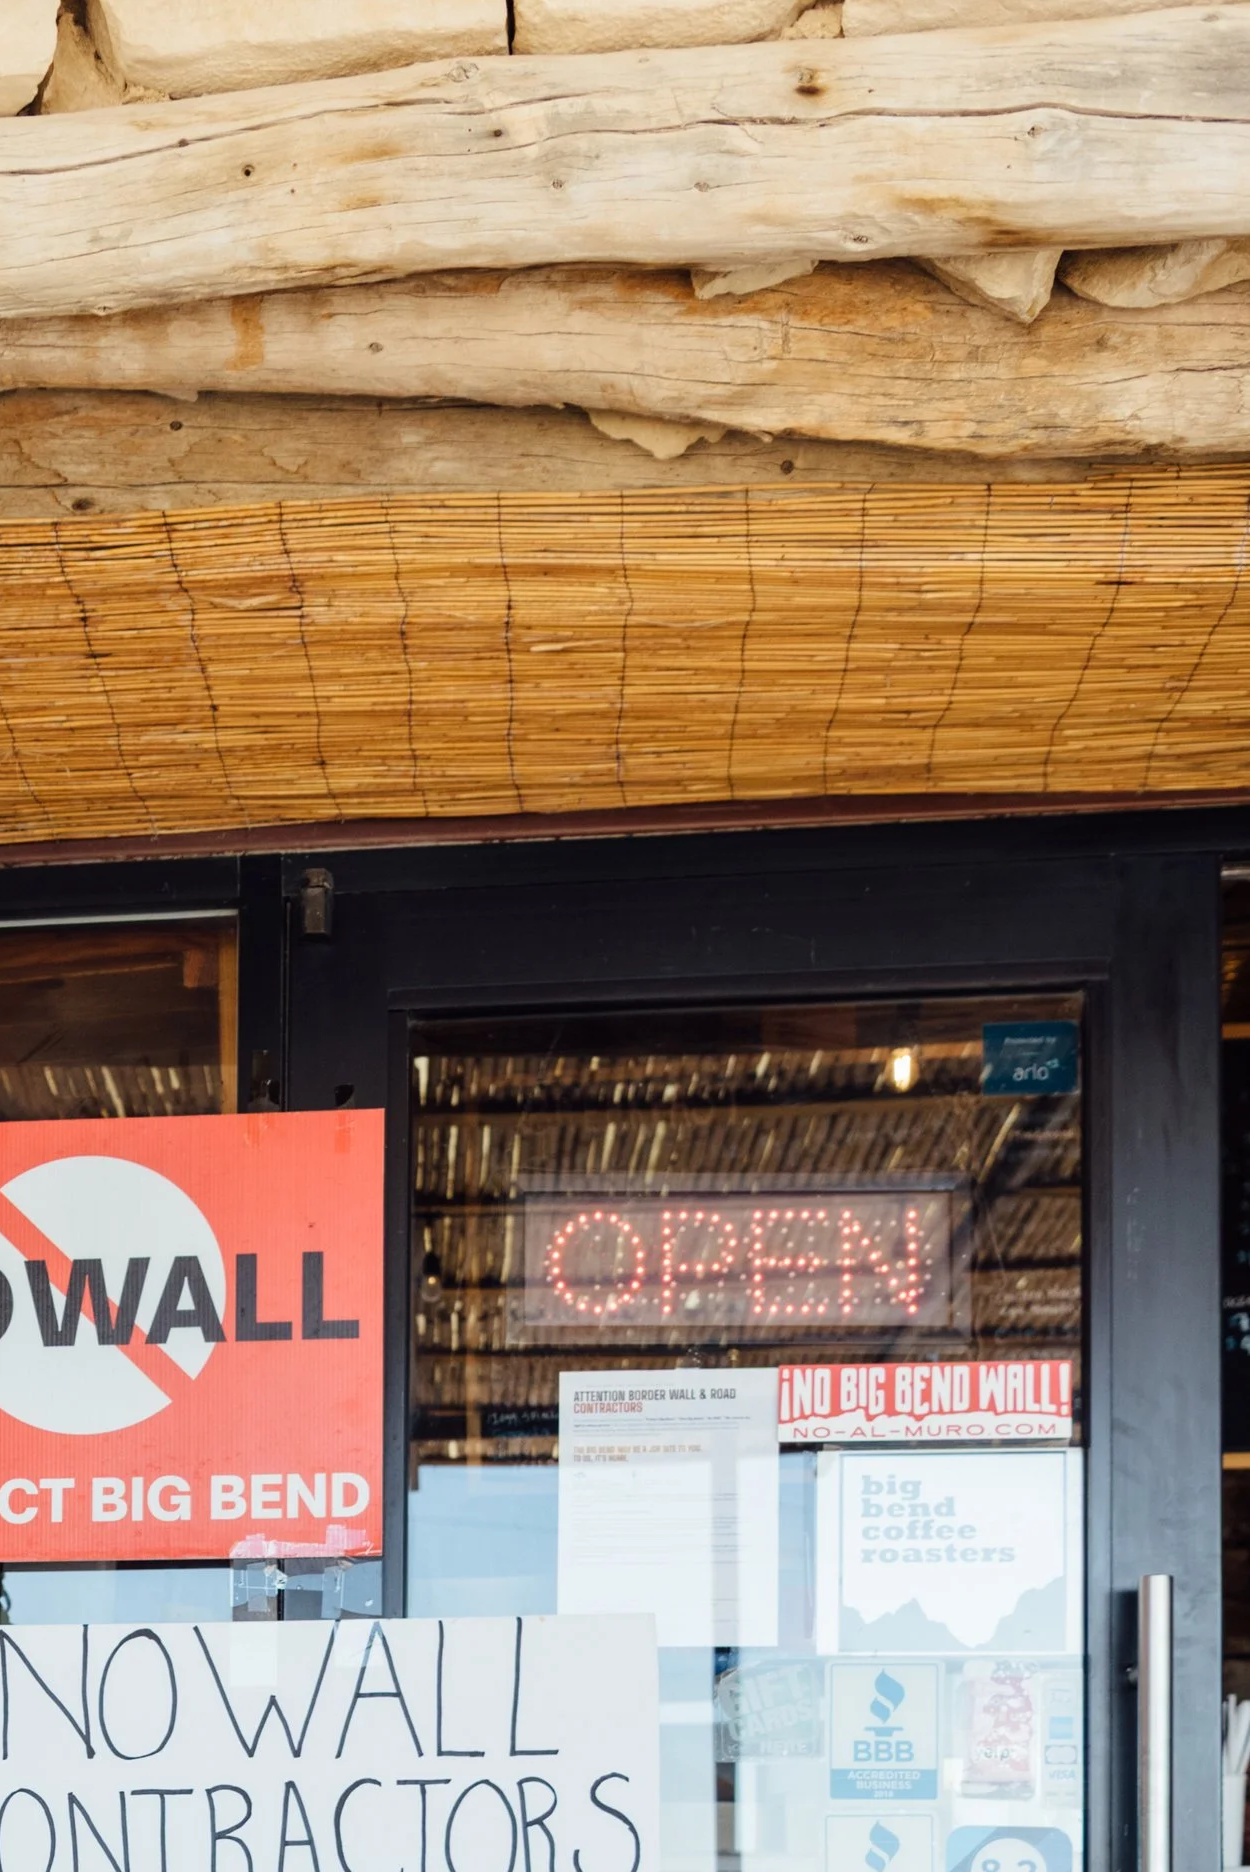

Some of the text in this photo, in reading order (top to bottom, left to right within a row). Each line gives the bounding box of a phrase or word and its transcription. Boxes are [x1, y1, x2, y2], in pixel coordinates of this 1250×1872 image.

[1012, 1063, 1049, 1082] arlo
[546, 1209, 932, 1315] OPEN
[573, 1388, 737, 1402] ATTENTION BORDER WALL & ROAD
[841, 1366, 885, 1415] BIG
[895, 1365, 970, 1416] BEND
[979, 1363, 1070, 1416] WALL!
[573, 1402, 643, 1414] CONTRACTORS
[793, 1423, 1057, 1439] NO-AL-MURO.COM
[91, 1475, 192, 1522] BIG
[211, 1472, 370, 1521] BEND
[861, 1475, 922, 1500] big
[861, 1497, 956, 1518] bend
[862, 1519, 977, 1540] coffee
[861, 1544, 1016, 1563] roasters
[193, 1616, 559, 1759] WALL
[853, 1740, 914, 1762] BBB
[848, 1771, 920, 1780] ACCREDITED
[856, 1780, 912, 1790] BUSINESS
[1049, 1771, 1076, 1780] VISA
